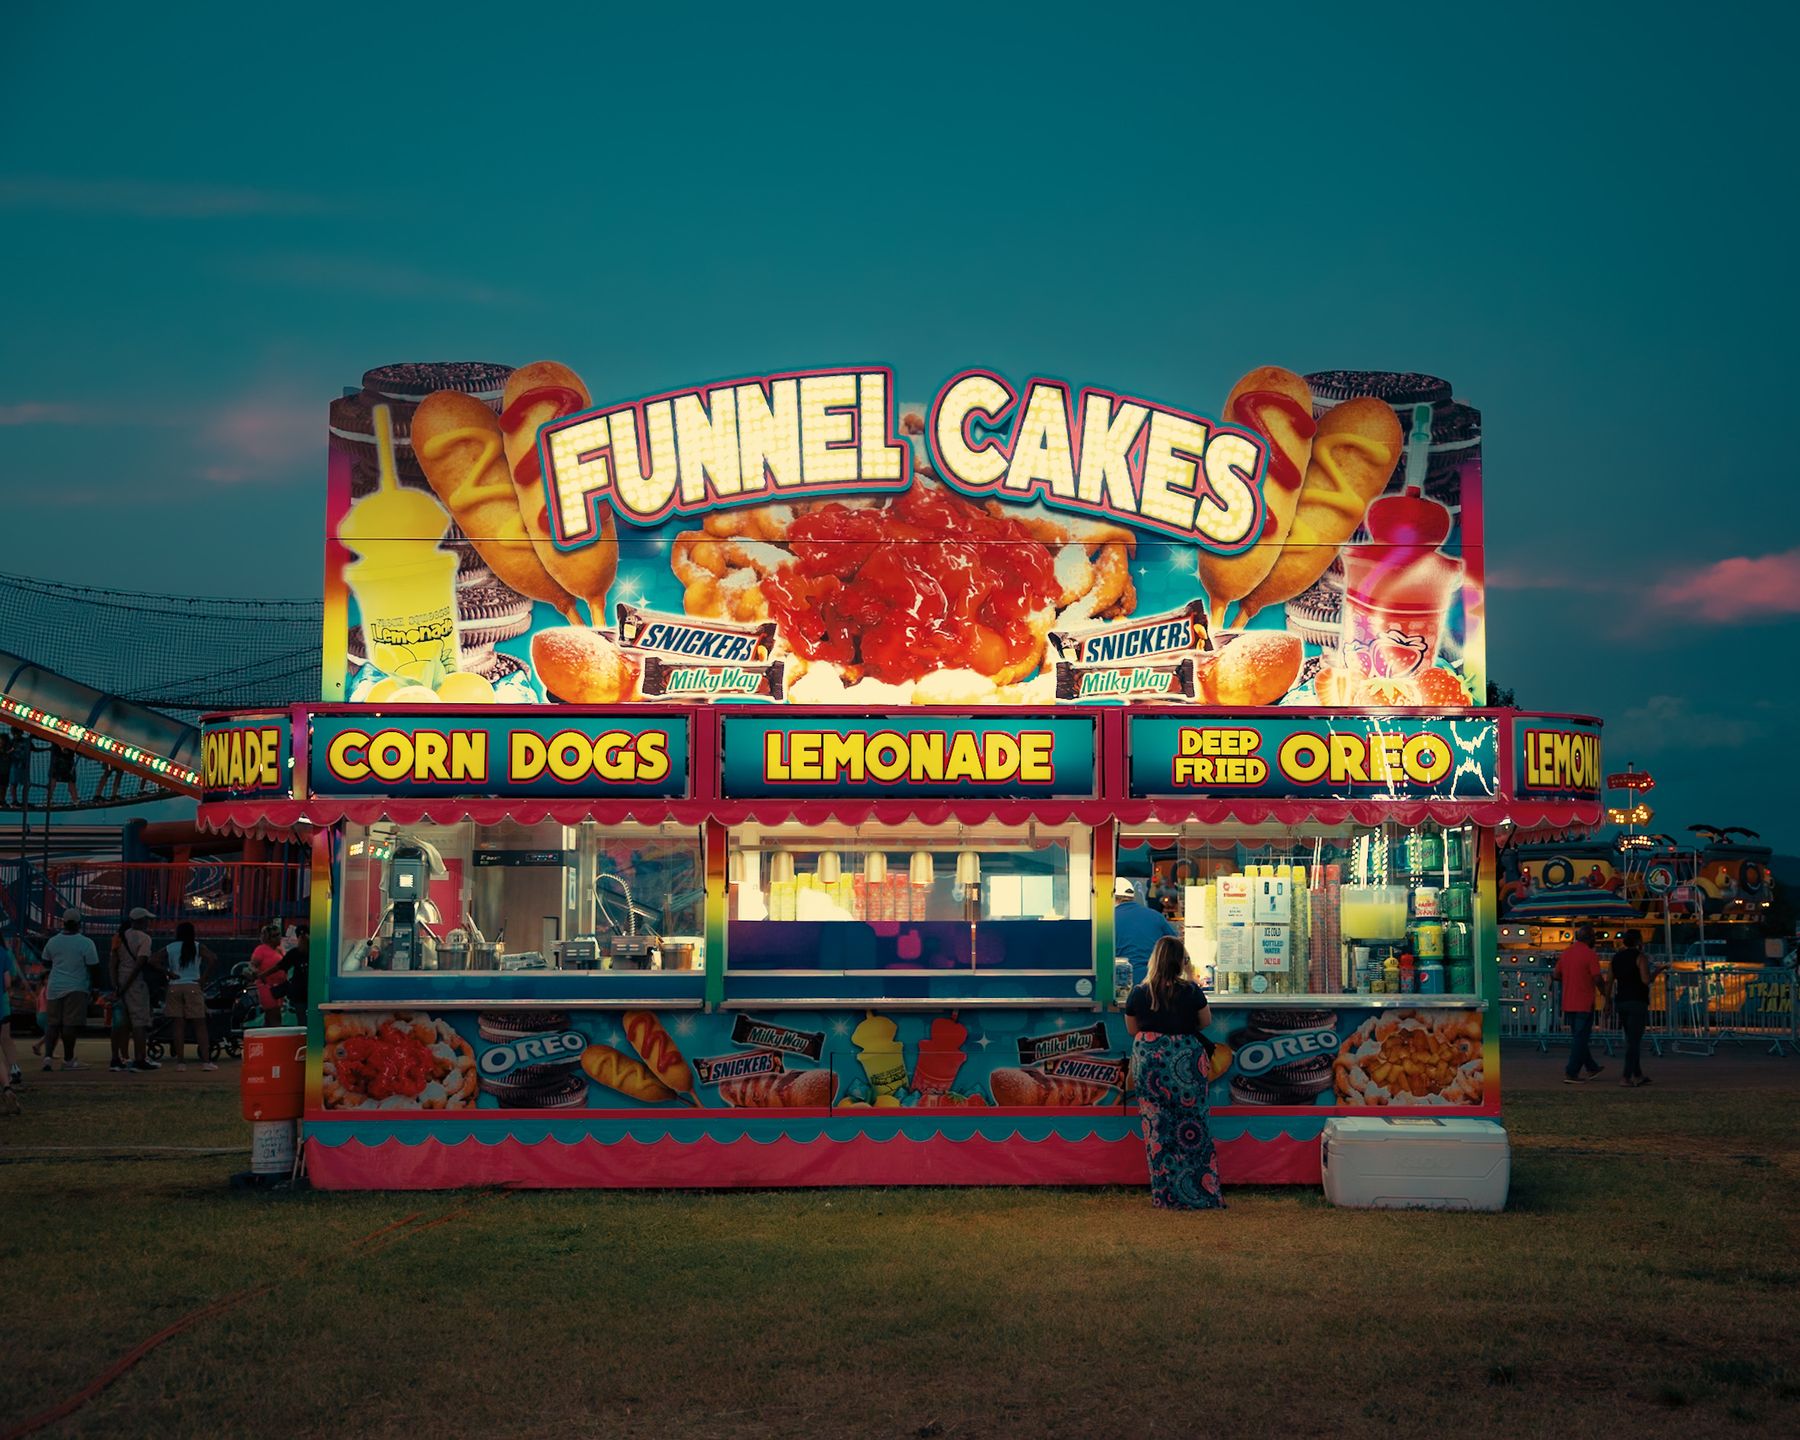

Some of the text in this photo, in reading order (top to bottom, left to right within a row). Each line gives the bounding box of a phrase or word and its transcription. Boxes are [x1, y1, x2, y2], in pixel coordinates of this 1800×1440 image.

[549, 372, 1260, 543] FUNNEL CAKES
[641, 623, 757, 662] SNICKERS
[1086, 620, 1190, 662] SNICKERS
[329, 731, 669, 780] CORN DOGS
[766, 732, 1052, 781] LEMONADE
[1181, 730, 1260, 755] DEEP
[1280, 733, 1452, 783] OREO
[1175, 758, 1267, 783] FRIED
[481, 1034, 583, 1073] OREO
[713, 1055, 772, 1079] SNICKERS
[1239, 1031, 1338, 1070] OREO
[1056, 1060, 1118, 1082] SNICKERS
